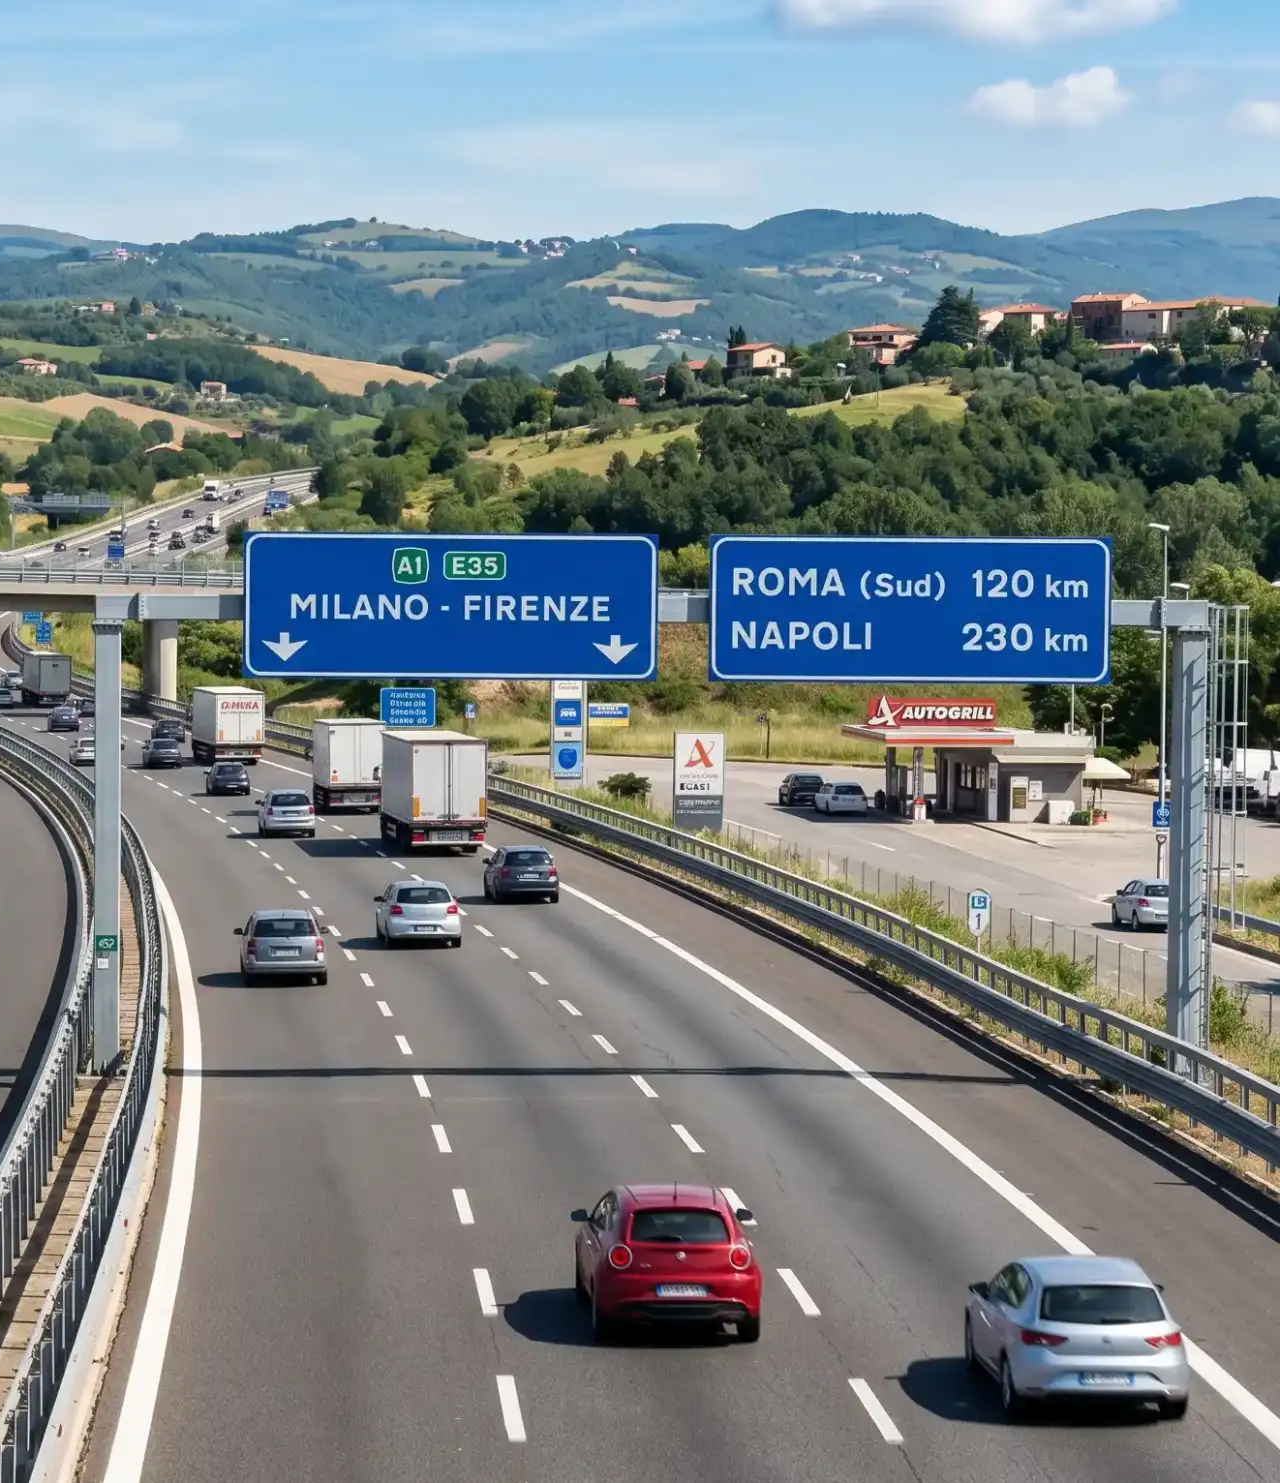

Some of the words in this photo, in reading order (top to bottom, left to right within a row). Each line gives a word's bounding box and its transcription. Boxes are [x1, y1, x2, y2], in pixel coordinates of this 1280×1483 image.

[398, 557, 422, 574] A1
[452, 556, 498, 575] E35
[732, 568, 846, 596] ROMA
[860, 570, 946, 602] (Sud)
[972, 569, 1034, 598] 120
[1045, 574, 1089, 598] km
[290, 593, 428, 620] MILANO
[464, 595, 610, 622] FIRENZE
[731, 622, 872, 650] NAPOLI
[962, 622, 1033, 652] 230
[1045, 628, 1088, 652] km
[902, 705, 995, 720] AUTOGRILL
